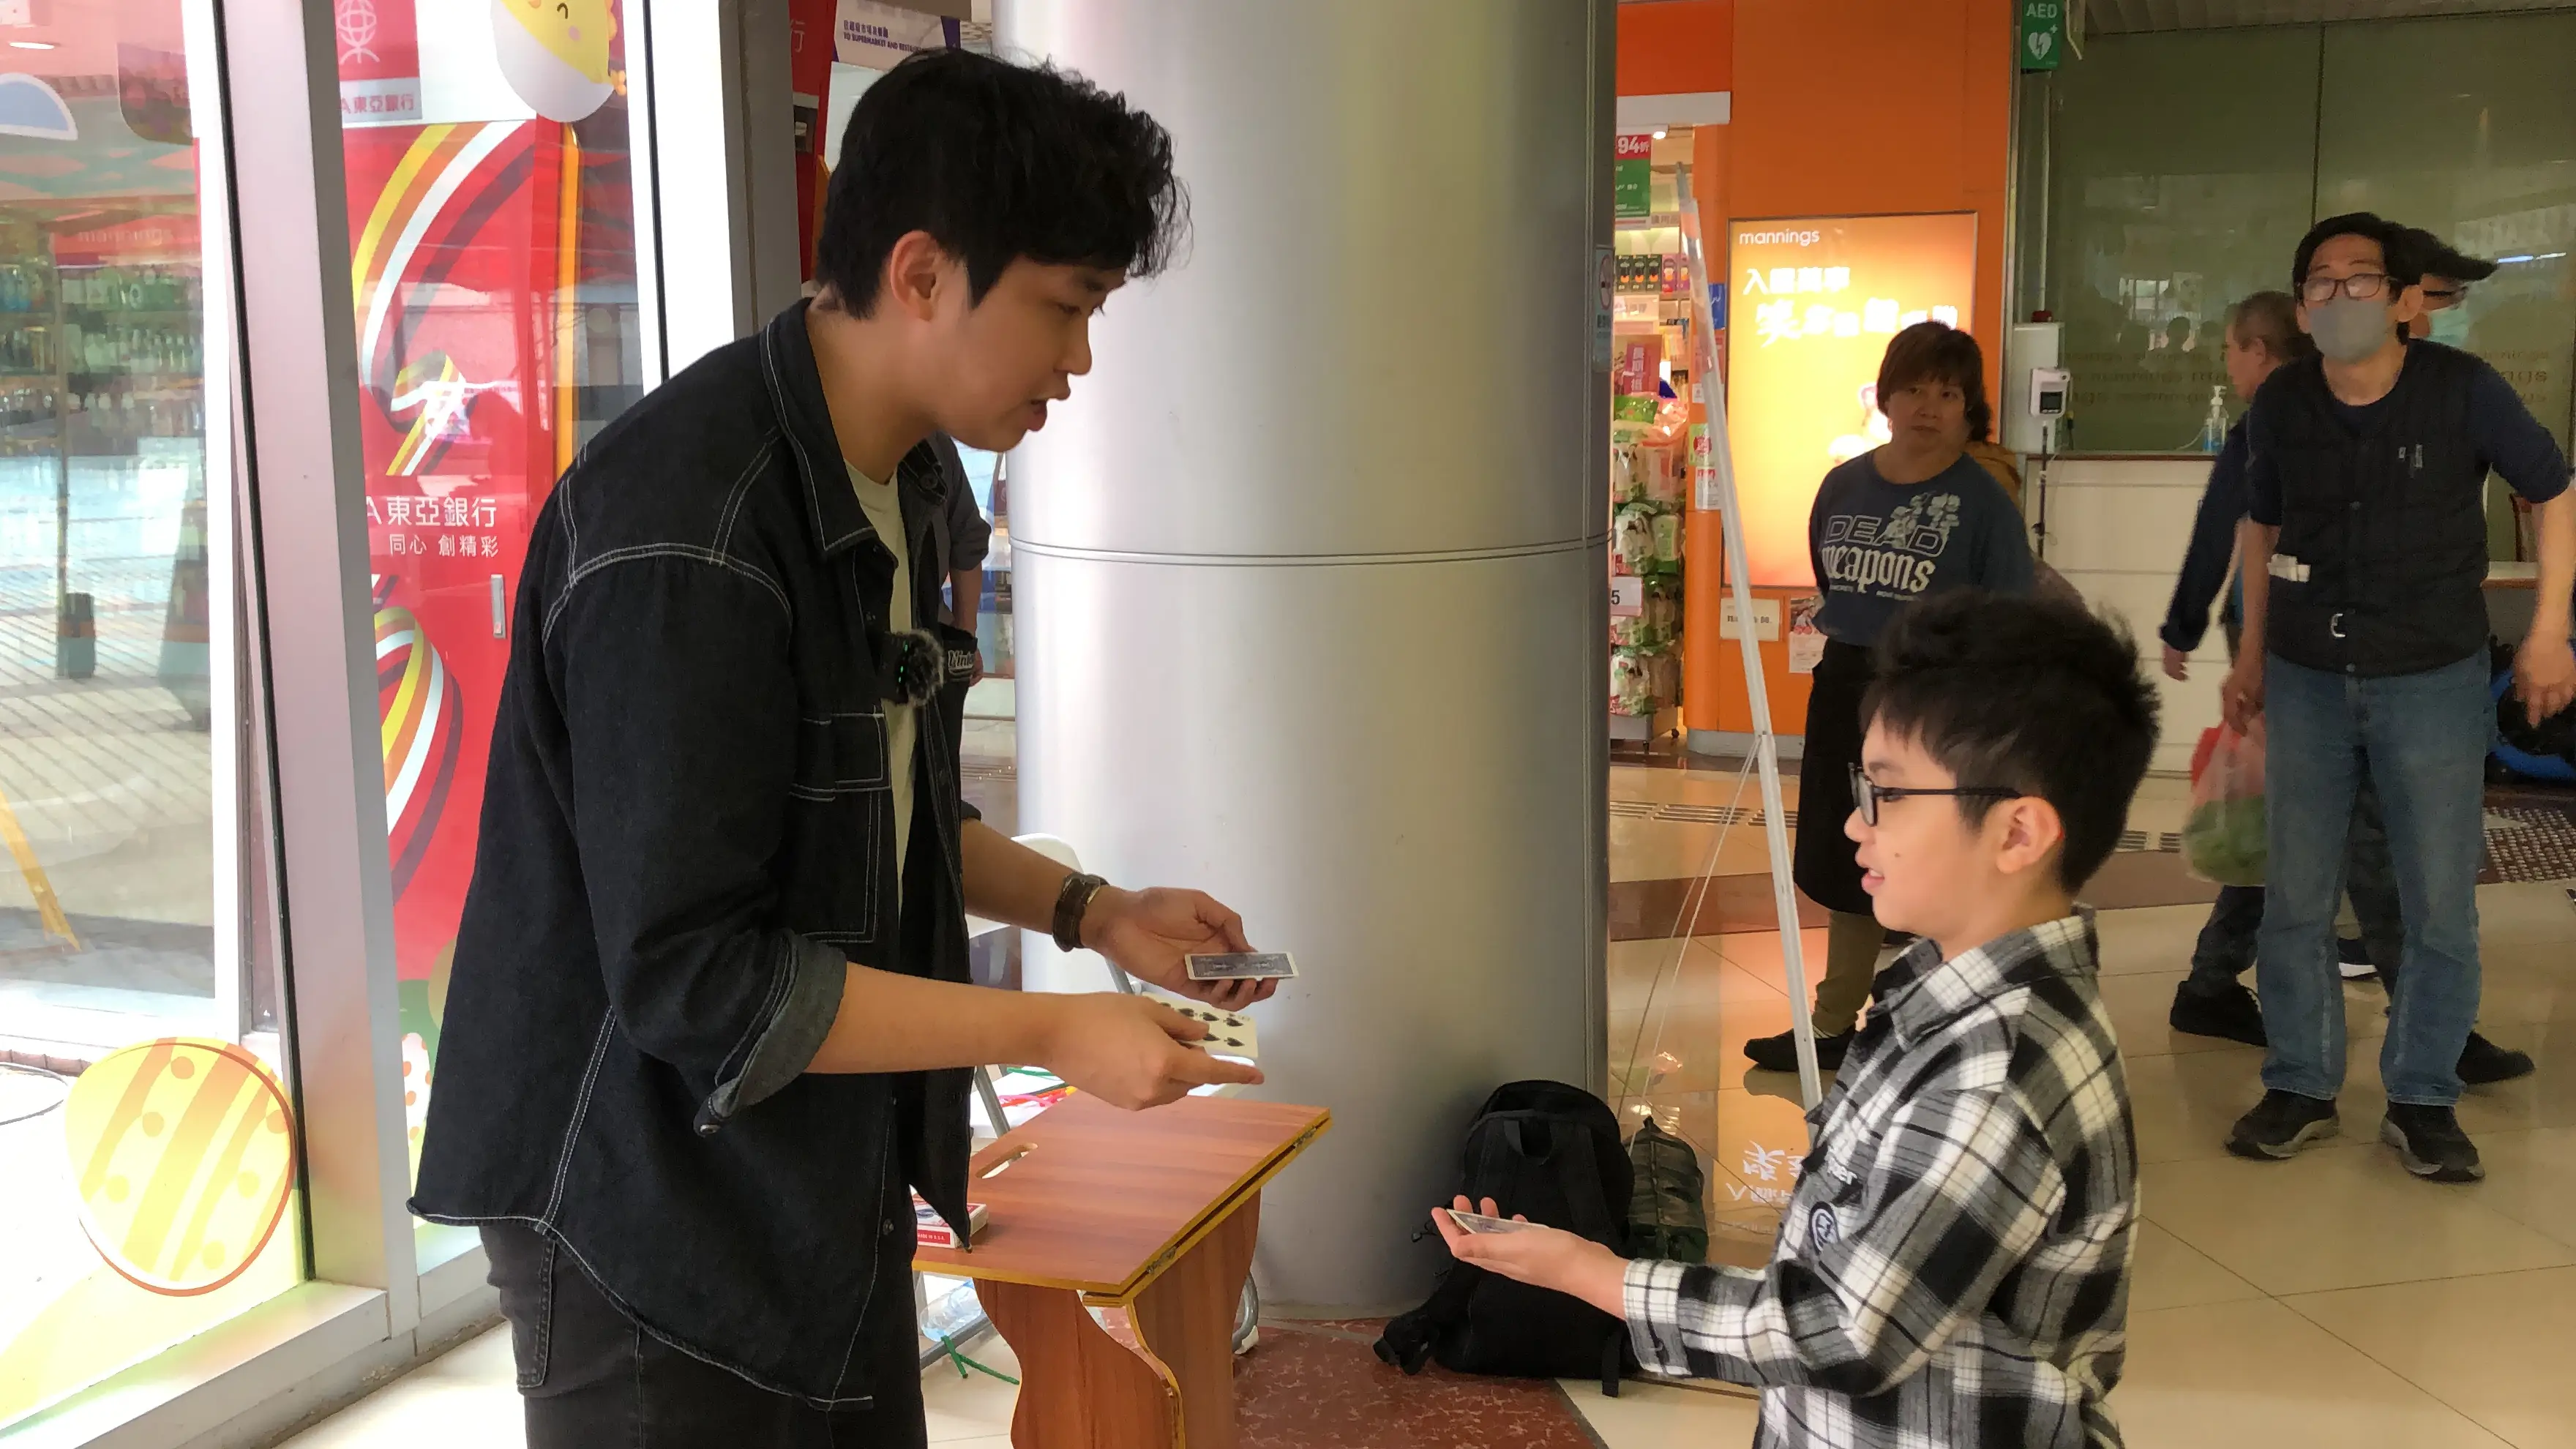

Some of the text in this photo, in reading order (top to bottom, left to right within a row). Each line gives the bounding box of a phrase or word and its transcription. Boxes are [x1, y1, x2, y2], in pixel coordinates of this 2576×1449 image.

[2026, 3, 2058, 18] AED
[844, 31, 851, 40] TO
[887, 41, 899, 50] AND
[1739, 228, 1820, 247] mannings
[389, 533, 499, 558] 同心 創精彩
[1824, 514, 1950, 558] DEAD
